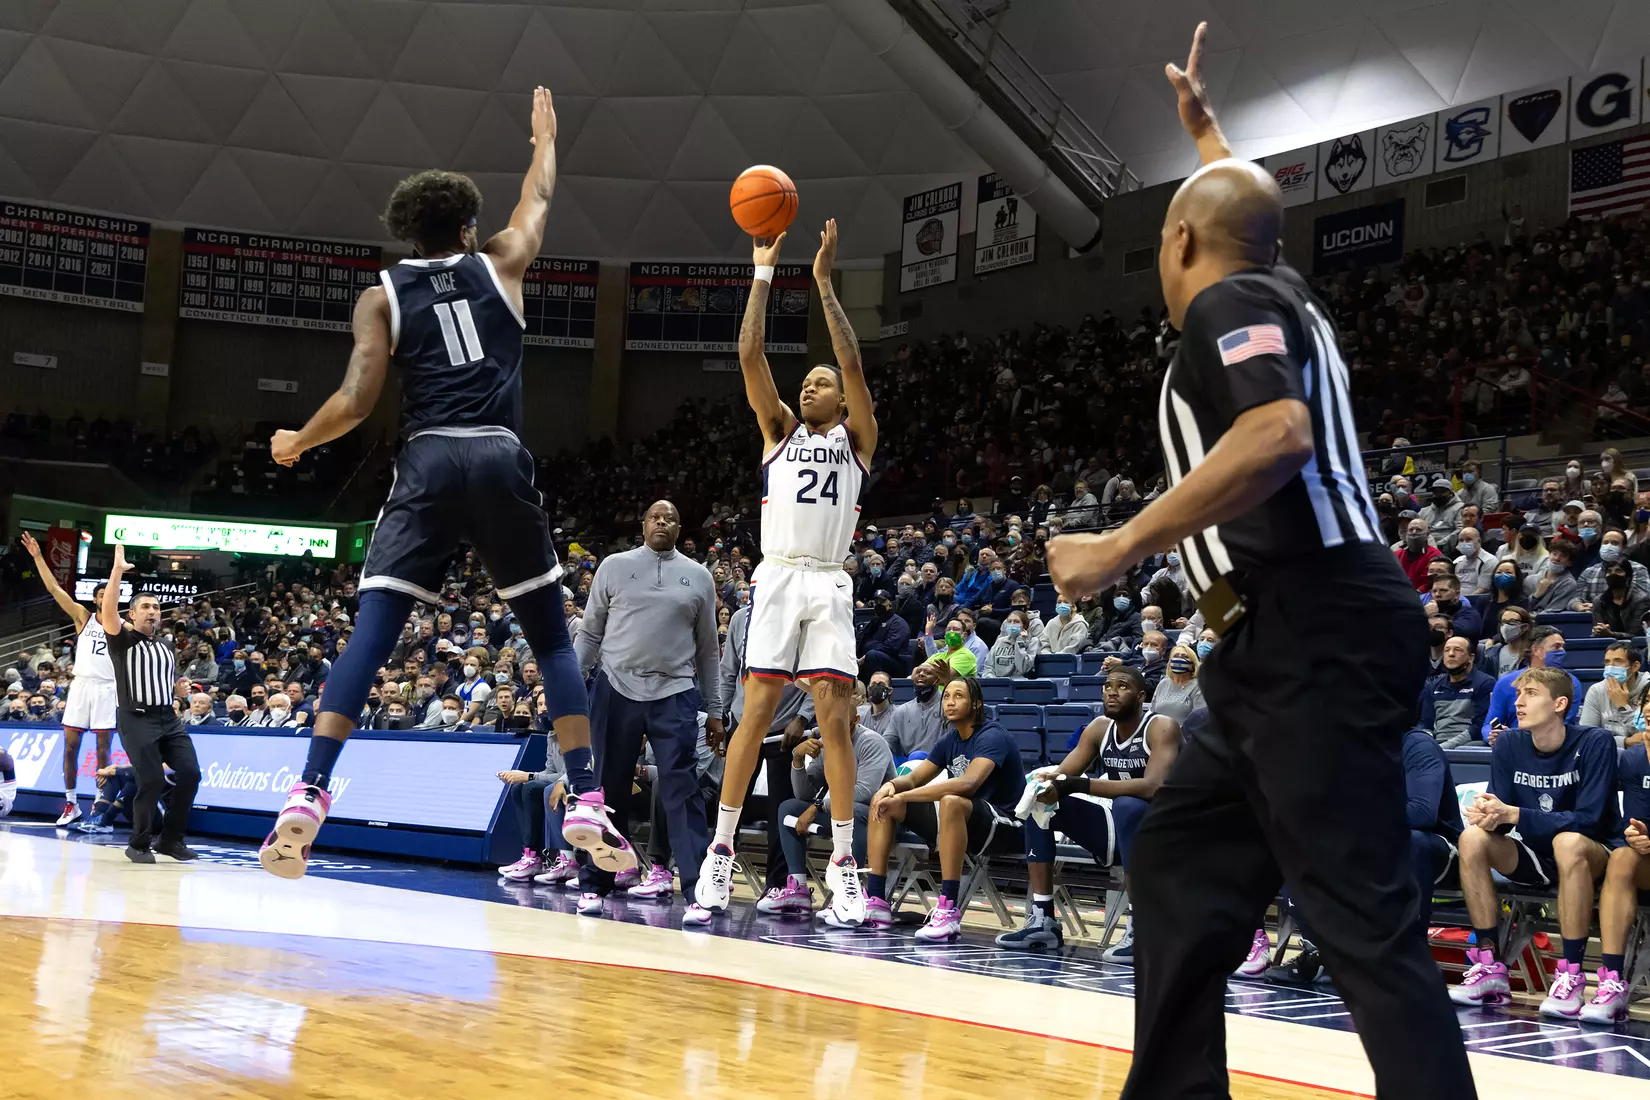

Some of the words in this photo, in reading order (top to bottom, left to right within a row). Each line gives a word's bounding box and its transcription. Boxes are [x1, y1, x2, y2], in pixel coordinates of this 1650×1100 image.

[1275, 162, 1306, 178] BIG
[909, 195, 923, 211] JIM
[924, 185, 959, 208] CALHOUN
[5, 205, 138, 233] CHAMPIONSHIP
[906, 208, 928, 221] CLASS
[43, 222, 139, 244] APPEARANCES
[1322, 219, 1393, 250] UCONN
[0, 229, 23, 244] 2003
[29, 233, 53, 248] 2004
[60, 238, 84, 253] 2005
[91, 242, 114, 257] 2006
[121, 246, 144, 261] 2008
[196, 232, 240, 244] NCAA
[249, 236, 371, 257] CHAMPIONSHIP
[981, 247, 993, 263] JIM
[997, 239, 1029, 259] CALHOUN
[28, 252, 52, 268] 2014
[58, 256, 82, 272] 2016
[91, 262, 111, 276] 2021
[234, 247, 276, 258] SWEET
[281, 252, 333, 264] SIXTEEN
[528, 260, 588, 272] ONSHIP
[216, 257, 237, 272] 1964
[244, 260, 265, 274] 1976
[273, 262, 293, 277] 1990
[301, 265, 321, 279] 1991
[328, 268, 349, 282] 1994
[356, 271, 377, 284] 1995
[641, 265, 681, 275] NCAA
[688, 265, 802, 277] CHAMPIOHIP
[243, 279, 264, 293] 1999
[270, 281, 292, 295] 2002
[299, 284, 321, 298] 2003
[326, 287, 349, 301] 2004
[431, 272, 455, 294] RICE
[547, 284, 568, 297] 2002
[573, 285, 595, 299] 2004
[687, 278, 719, 286] FINAL
[23, 289, 58, 300] MEN'S
[63, 295, 137, 311] BASKETBALL
[183, 292, 207, 306] 2009
[212, 295, 235, 309] 2011
[241, 297, 263, 311] 2014
[185, 309, 261, 322] CONNECTICUT
[266, 316, 299, 326] MEN'S
[433, 299, 484, 366] 11
[523, 336, 589, 347] BASKETBALL
[630, 341, 700, 351] CONNECTICUT
[703, 342, 734, 351] MEN'S
[786, 447, 850, 465] UCONN
[797, 469, 838, 506] 24
[92, 639, 106, 655] 12
[1103, 757, 1147, 769] GEORGETOWN
[202, 761, 272, 792] Solutions
[1513, 769, 1581, 789] GEORGETOWN
